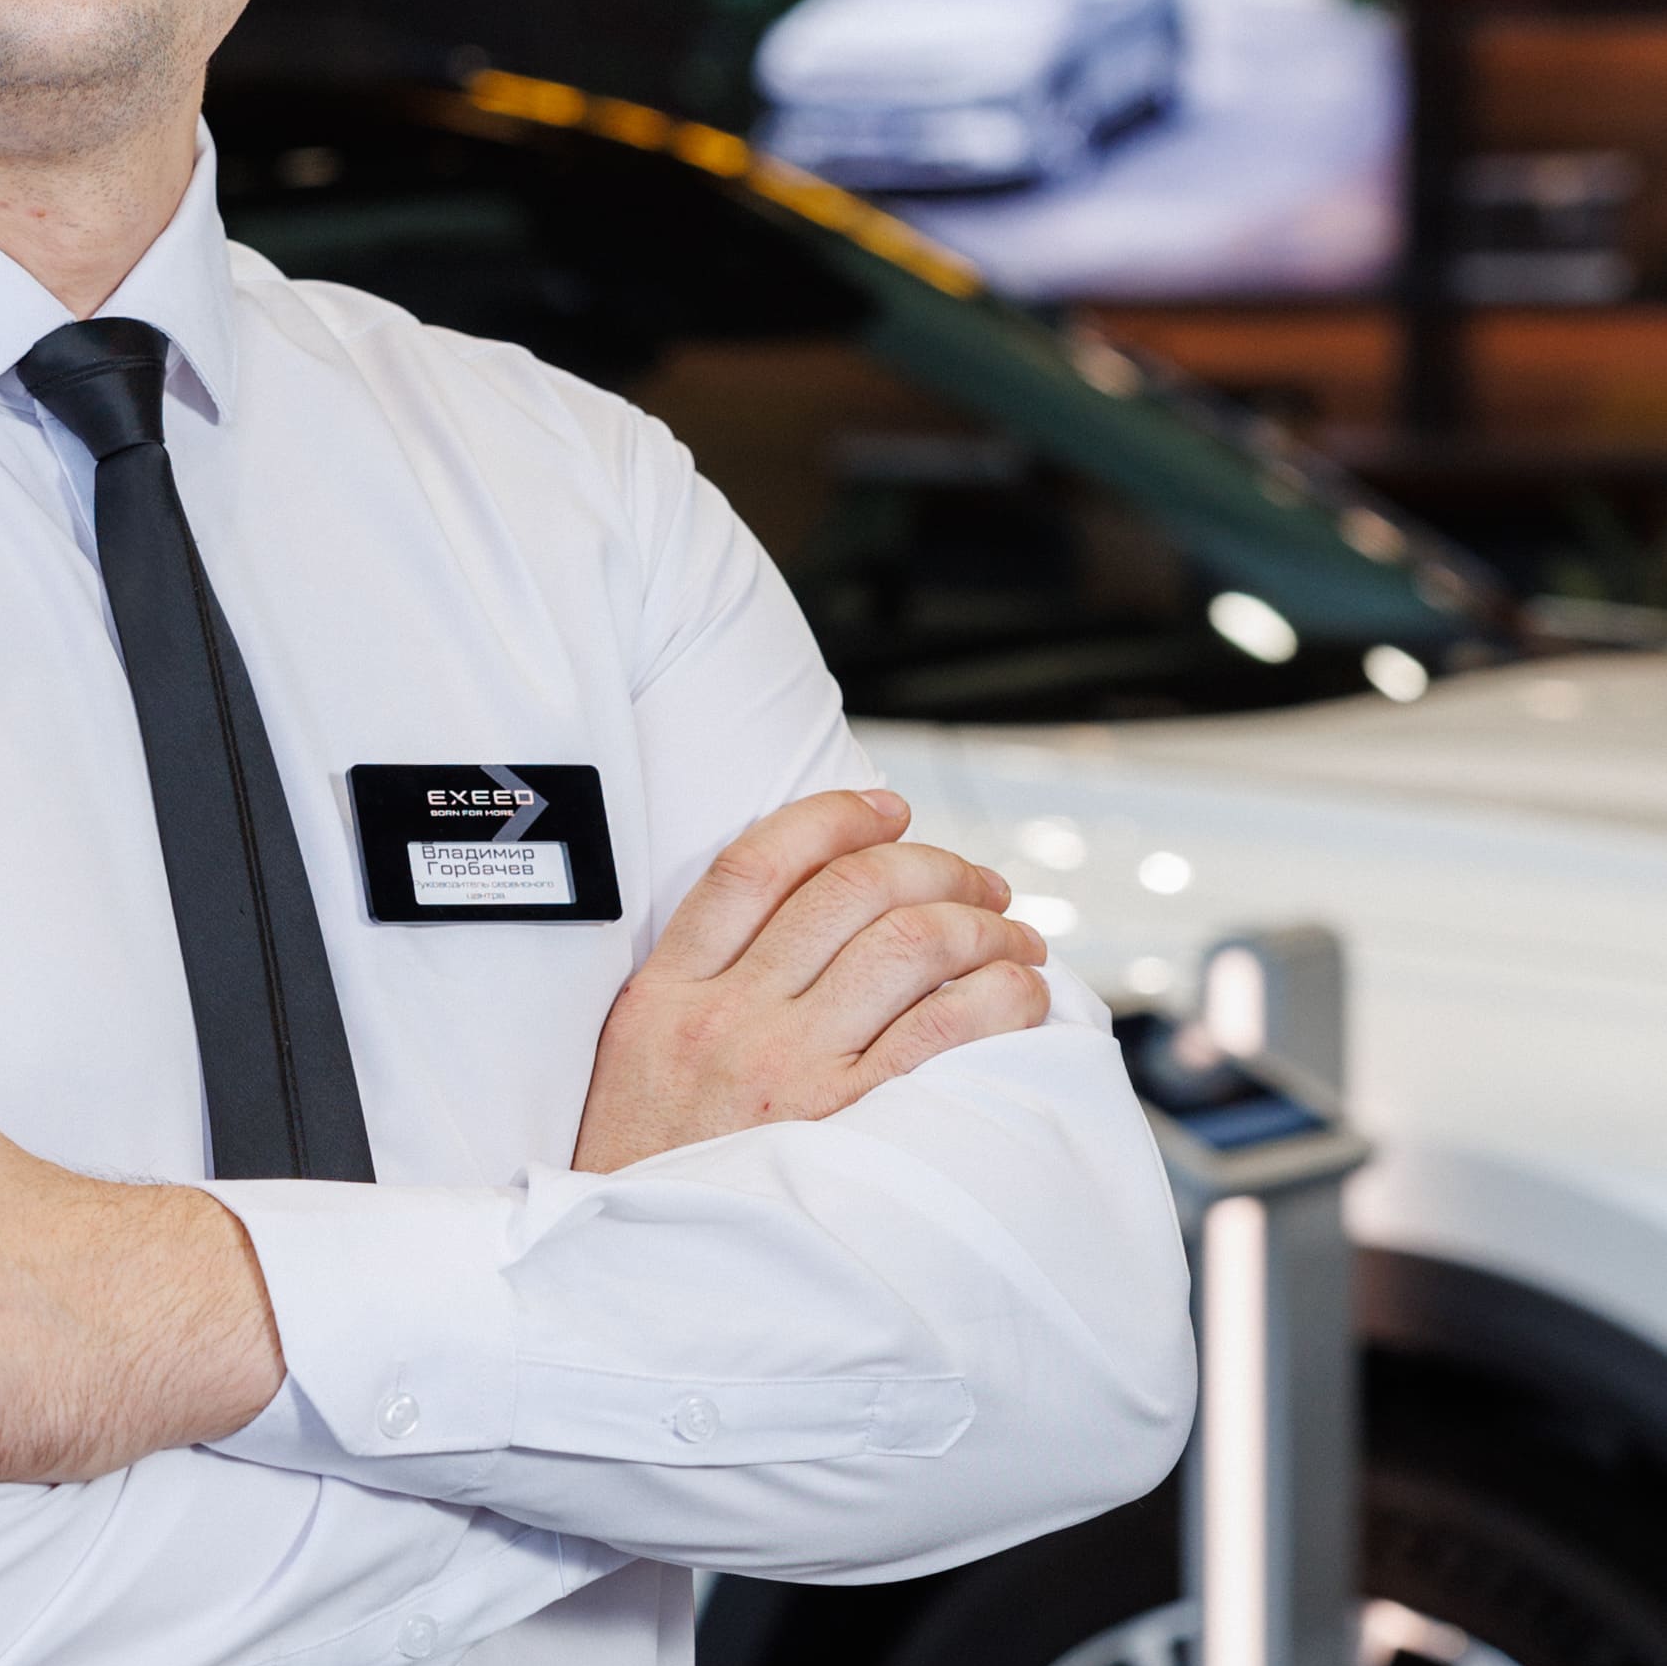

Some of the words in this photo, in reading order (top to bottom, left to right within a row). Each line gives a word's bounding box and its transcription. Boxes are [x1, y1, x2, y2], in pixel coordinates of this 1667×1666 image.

[426, 789, 535, 806] EXEED
[430, 809, 461, 817] BORN
[461, 809, 483, 817] FOR
[485, 809, 515, 817] MORE
[421, 845, 535, 862] Владимир
[427, 861, 534, 877] Горбачев
